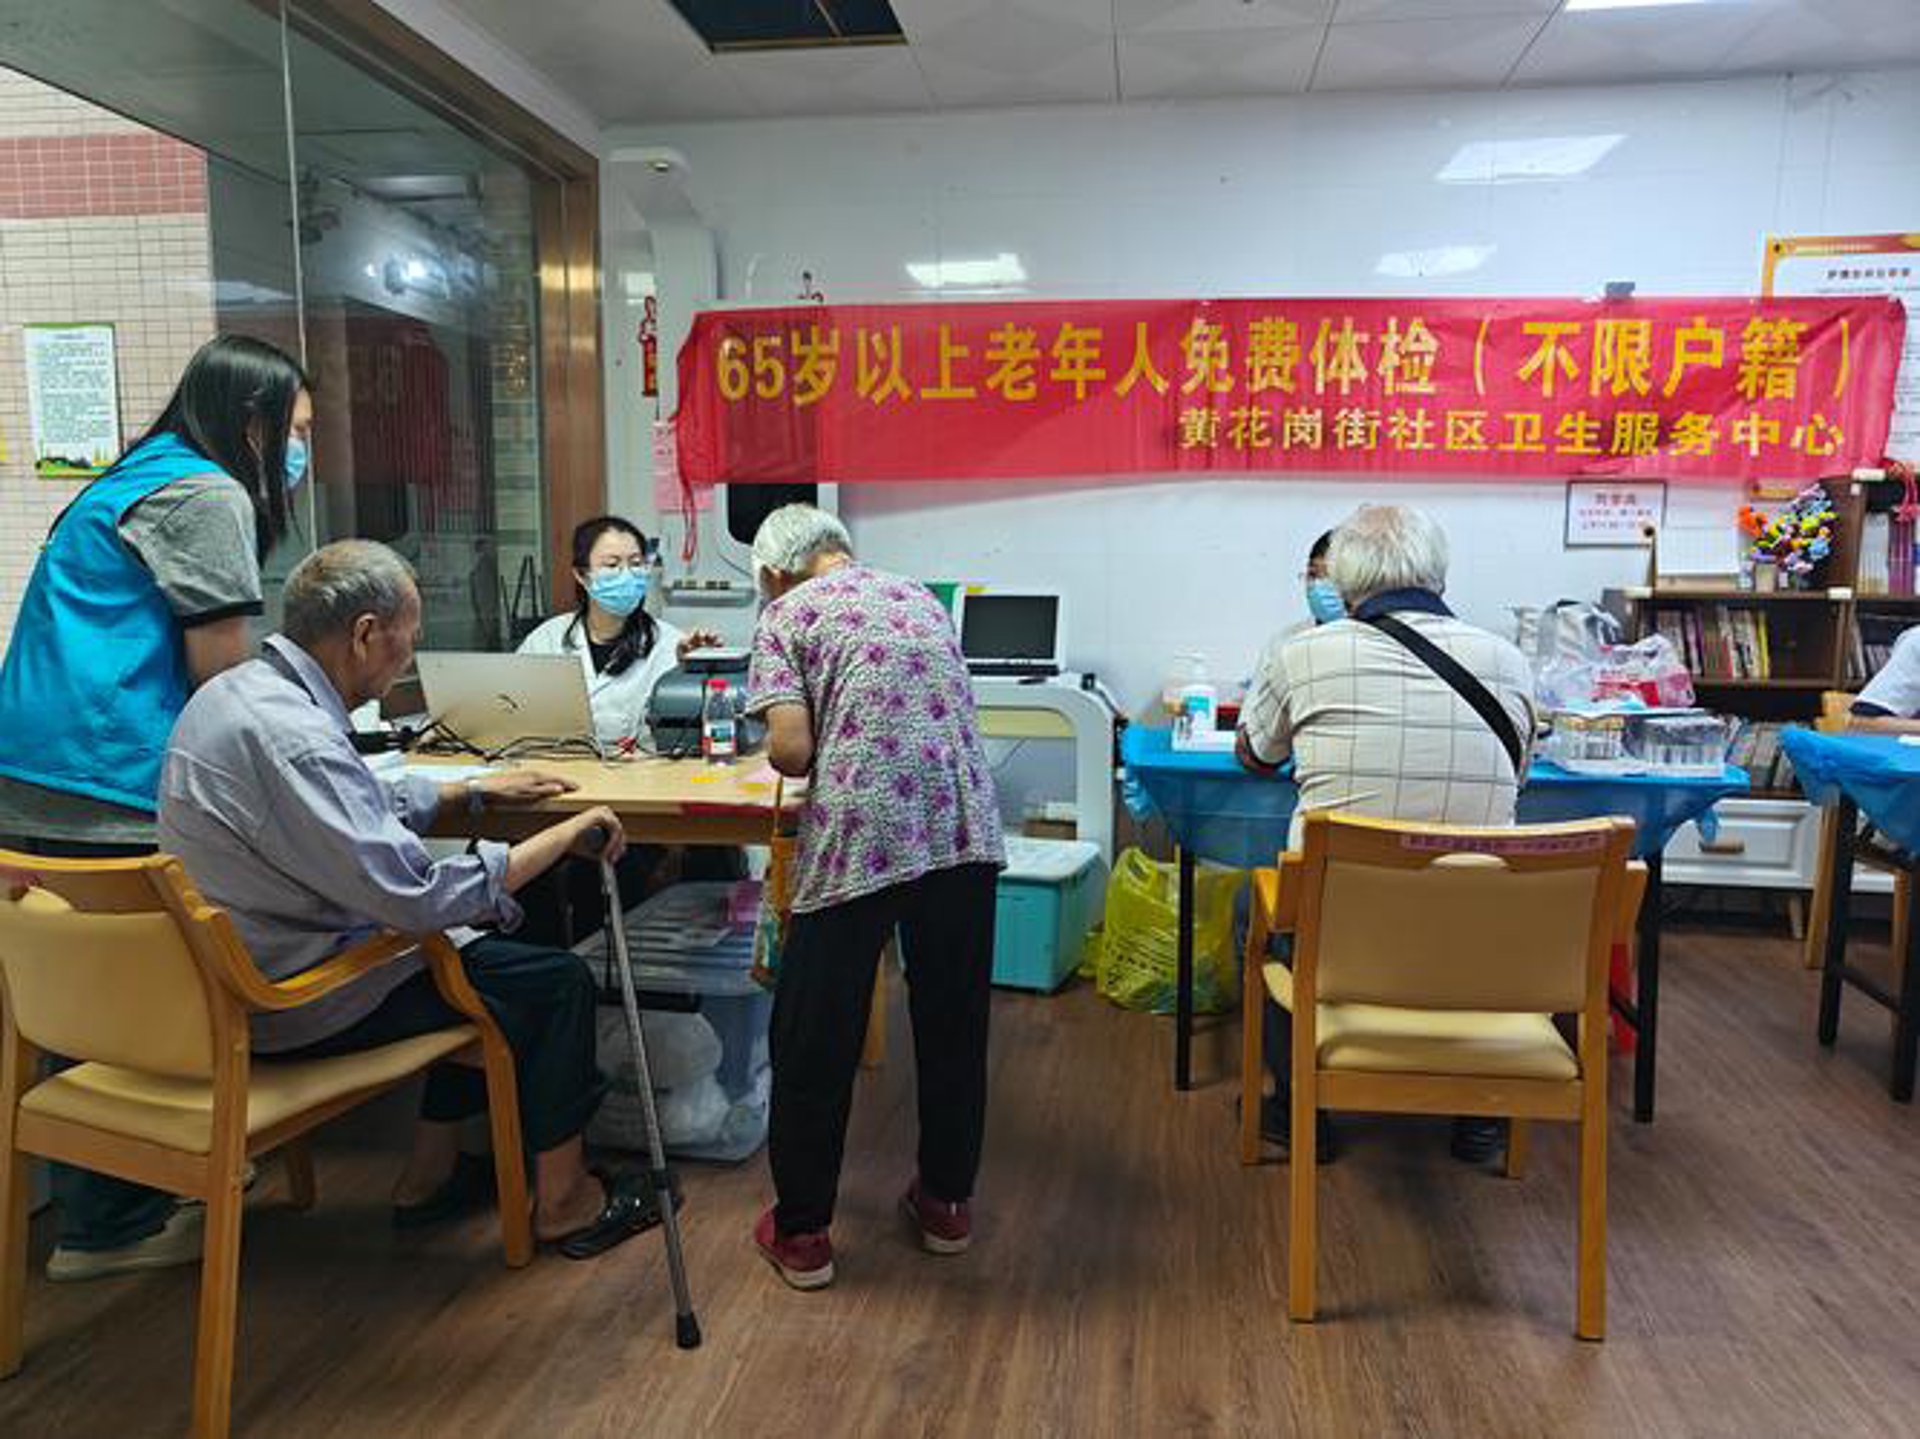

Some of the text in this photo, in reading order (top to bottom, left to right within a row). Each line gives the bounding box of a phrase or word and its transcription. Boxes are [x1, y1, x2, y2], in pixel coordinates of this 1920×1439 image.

[1178, 406, 1846, 457] 黄花岗街社区卫生服务中心
